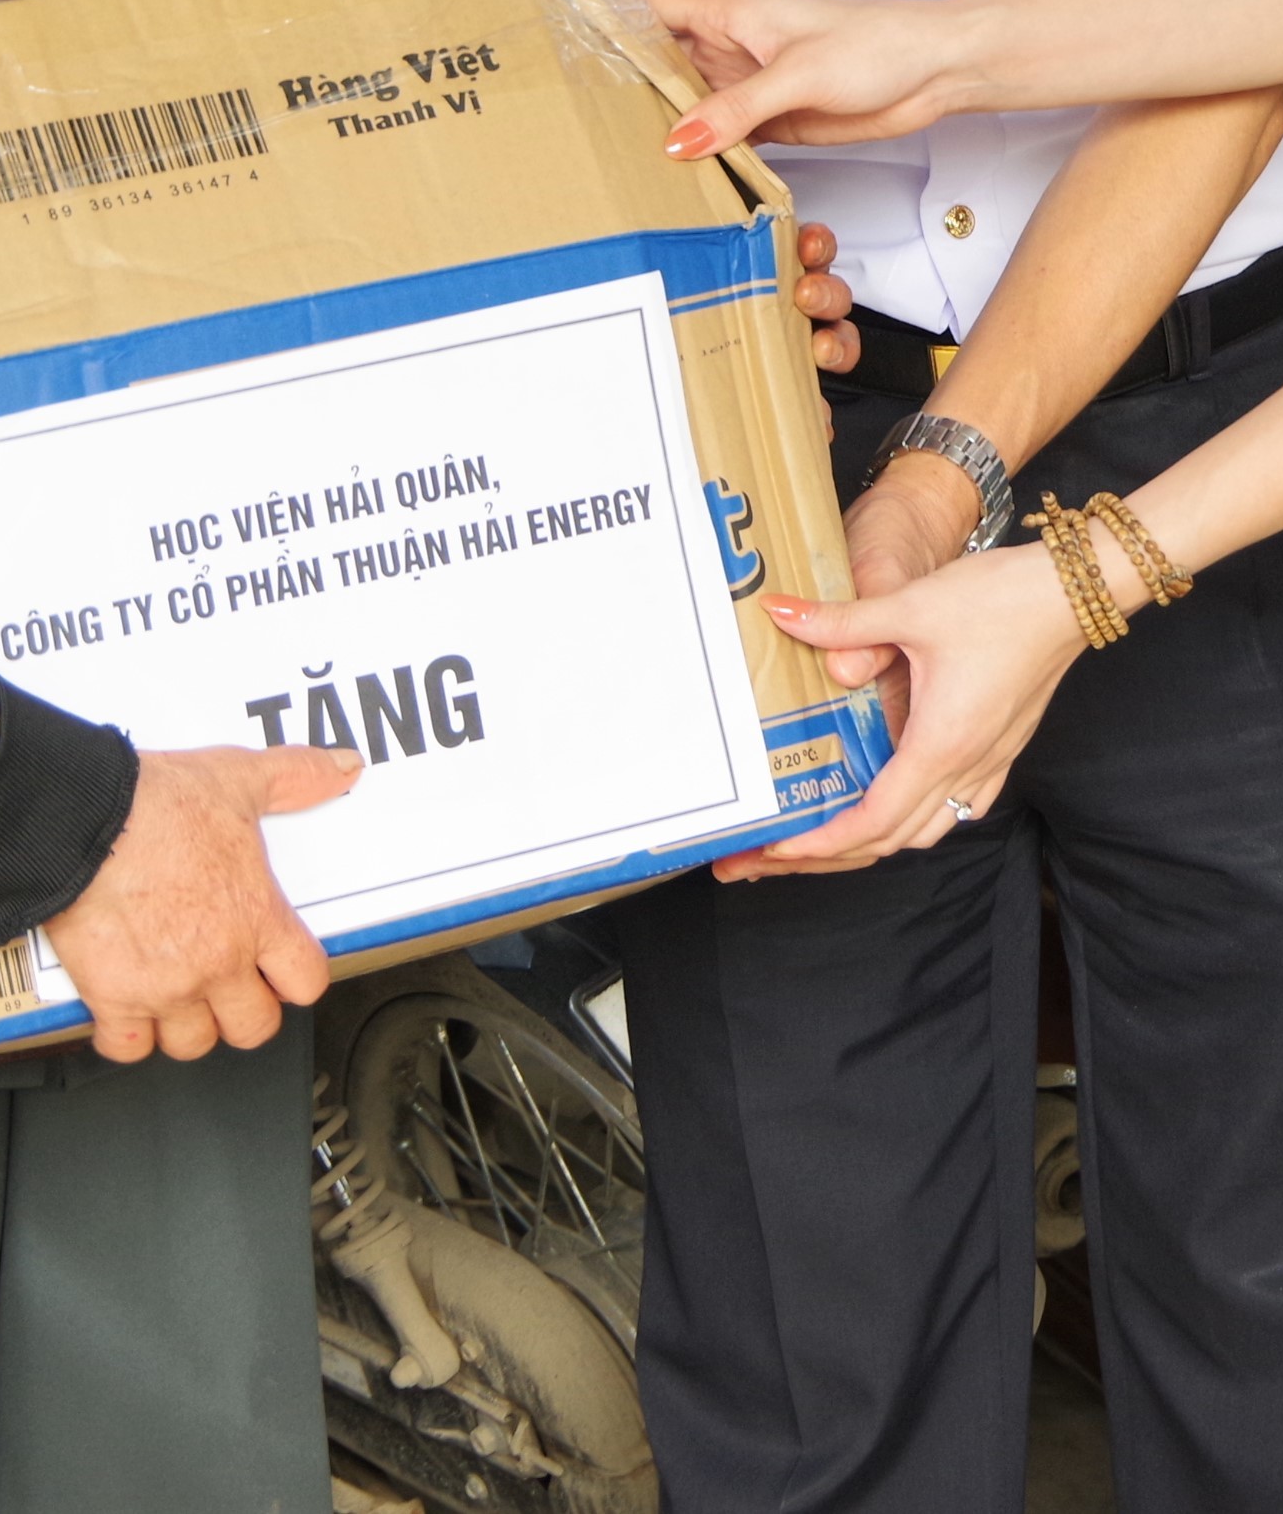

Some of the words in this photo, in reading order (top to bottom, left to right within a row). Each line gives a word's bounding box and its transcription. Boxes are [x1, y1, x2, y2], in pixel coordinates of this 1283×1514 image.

[278, 66, 400, 110] Hàng
[403, 43, 500, 82] Việt
[327, 101, 435, 138] Thanh
[443, 89, 482, 116] Vị
[49, 205, 72, 221] 89
[90, 190, 154, 213] 36134
[170, 174, 232, 197] 36147
[249, 169, 259, 182] 4
[148, 513, 223, 565] HỌC
[231, 491, 315, 544] VIỆN
[323, 464, 385, 525] HẢI
[395, 455, 501, 513] QUÂN,
[0, 605, 105, 661] CÔNG
[113, 594, 155, 633] TY
[168, 564, 214, 625] CỔ
[228, 547, 325, 612] PHẦN
[333, 528, 450, 582] THUẬN
[458, 501, 518, 561] HẢI
[528, 484, 653, 546] ENERGY
[784, 752, 801, 768] 20
